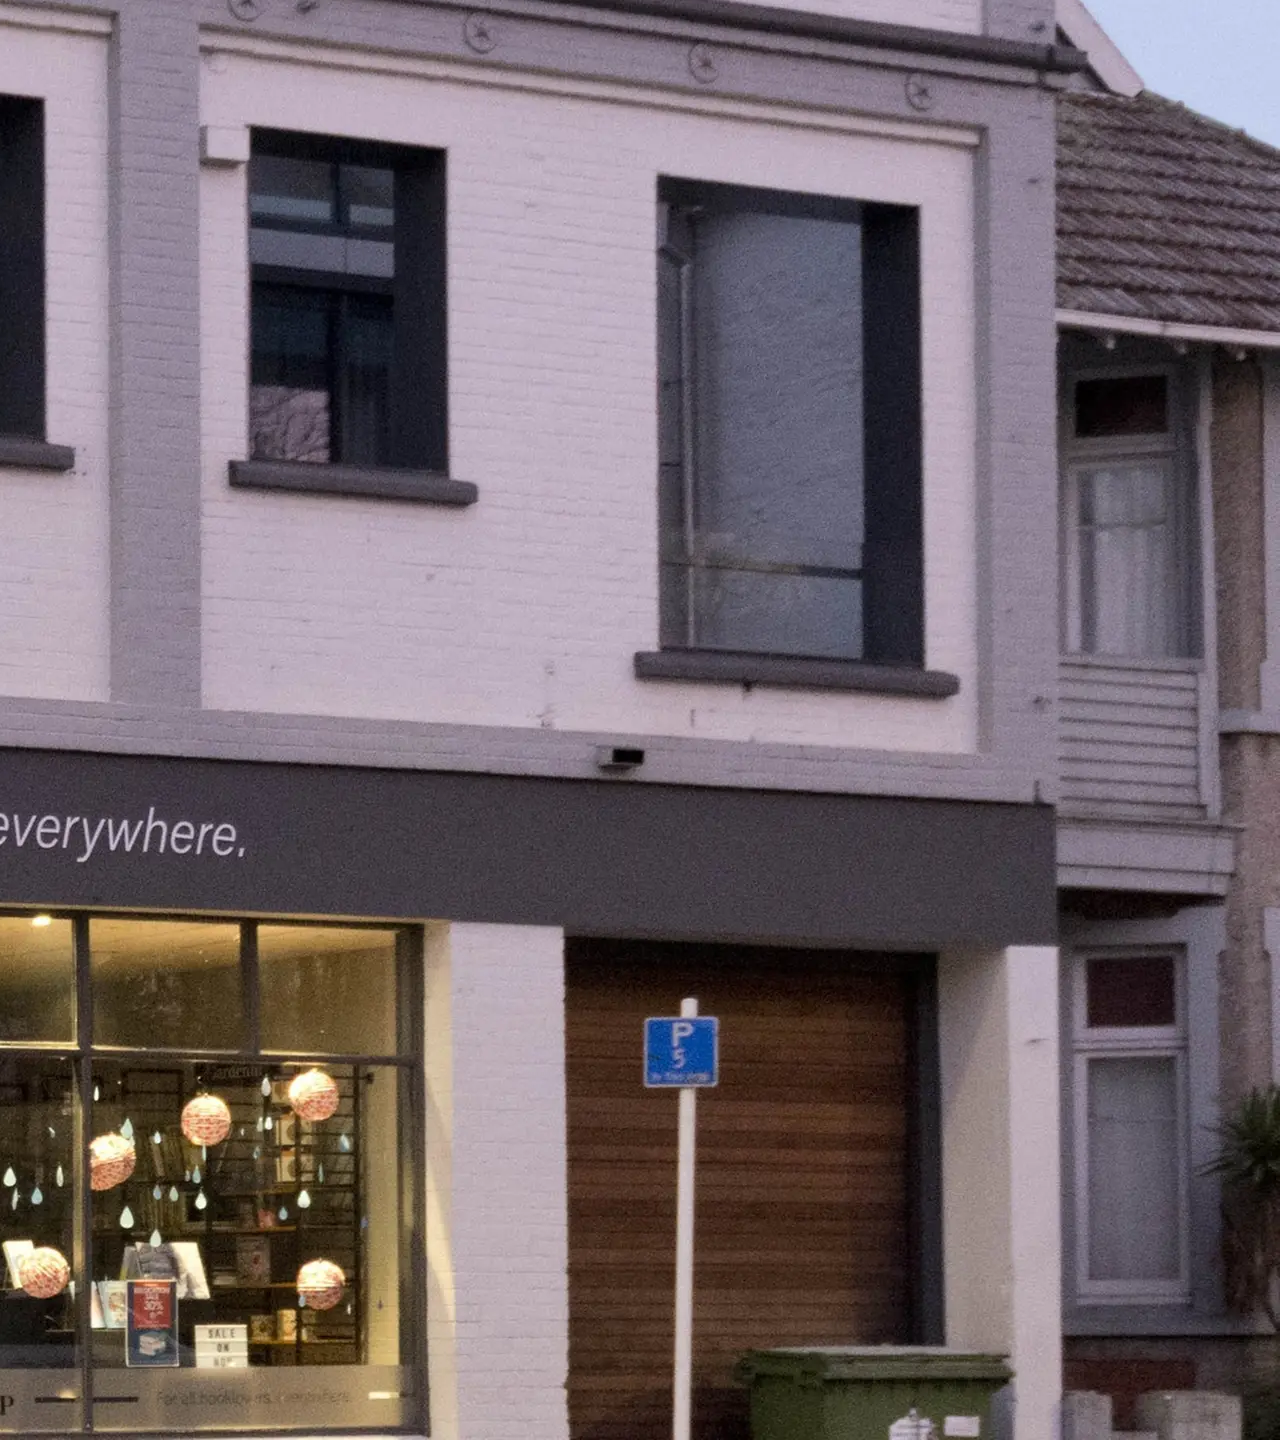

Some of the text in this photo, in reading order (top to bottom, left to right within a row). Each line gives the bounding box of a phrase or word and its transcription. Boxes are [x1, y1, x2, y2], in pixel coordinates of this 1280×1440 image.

[672, 1022, 694, 1047] P
[672, 1048, 686, 1069] 5
[207, 1327, 236, 1339] SALE
